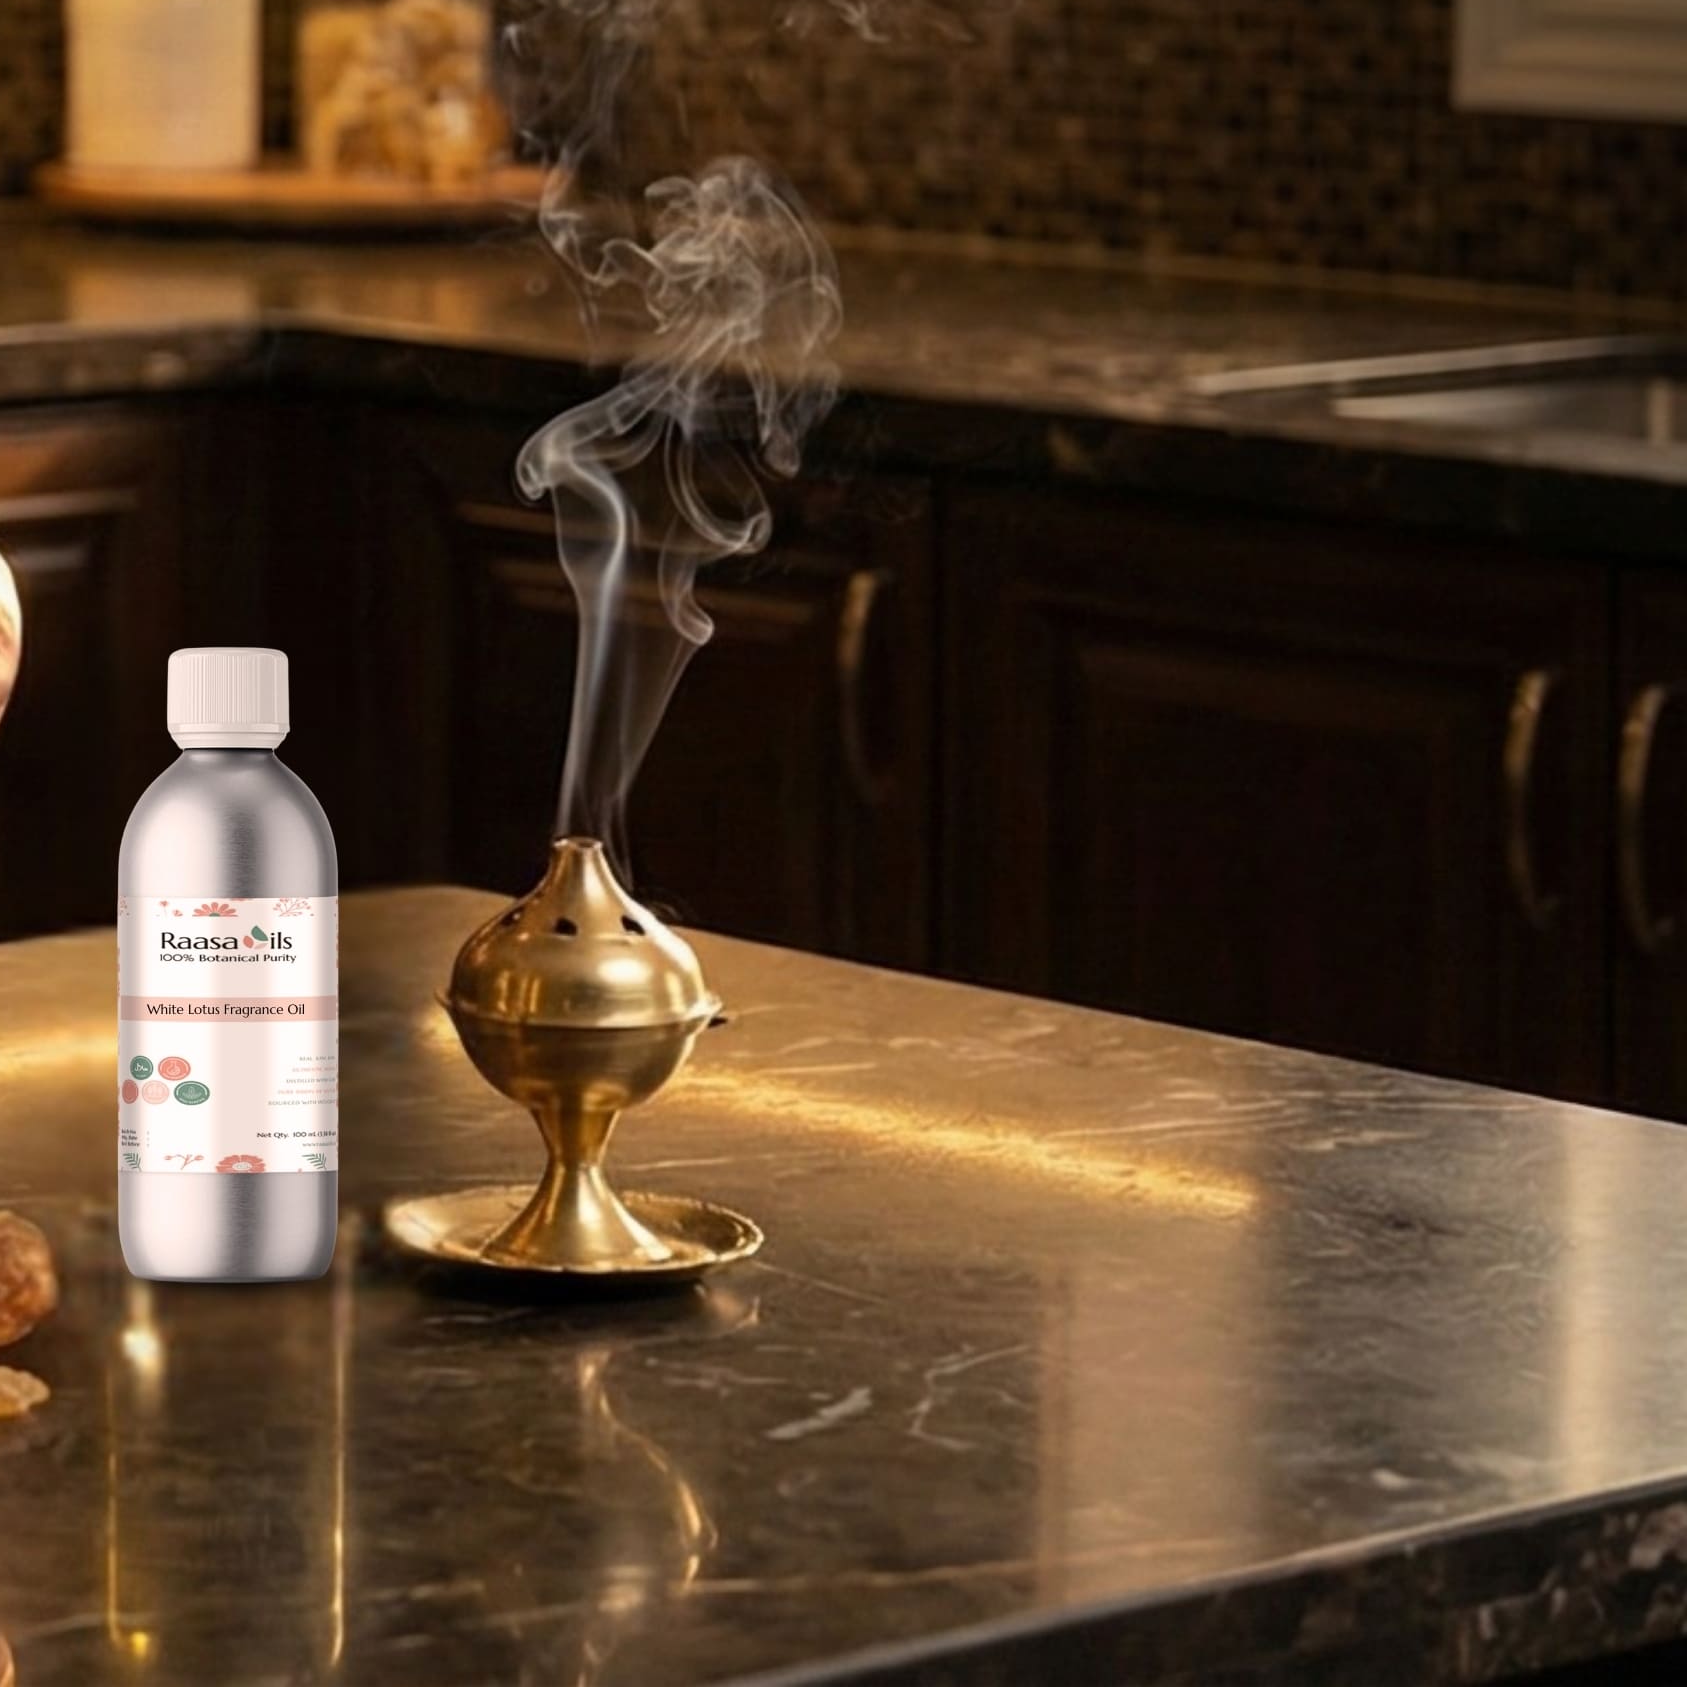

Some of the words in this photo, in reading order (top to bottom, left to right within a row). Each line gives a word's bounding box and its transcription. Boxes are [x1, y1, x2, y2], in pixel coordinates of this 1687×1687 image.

[161, 932, 238, 950] Raasa
[159, 953, 195, 962] 100%
[199, 953, 259, 962] Botanical
[263, 953, 297, 963] Purity
[146, 1003, 184, 1015] White
[188, 1003, 220, 1015] Lotus
[224, 1003, 284, 1018] Fragrance
[287, 1003, 305, 1015] Oil
